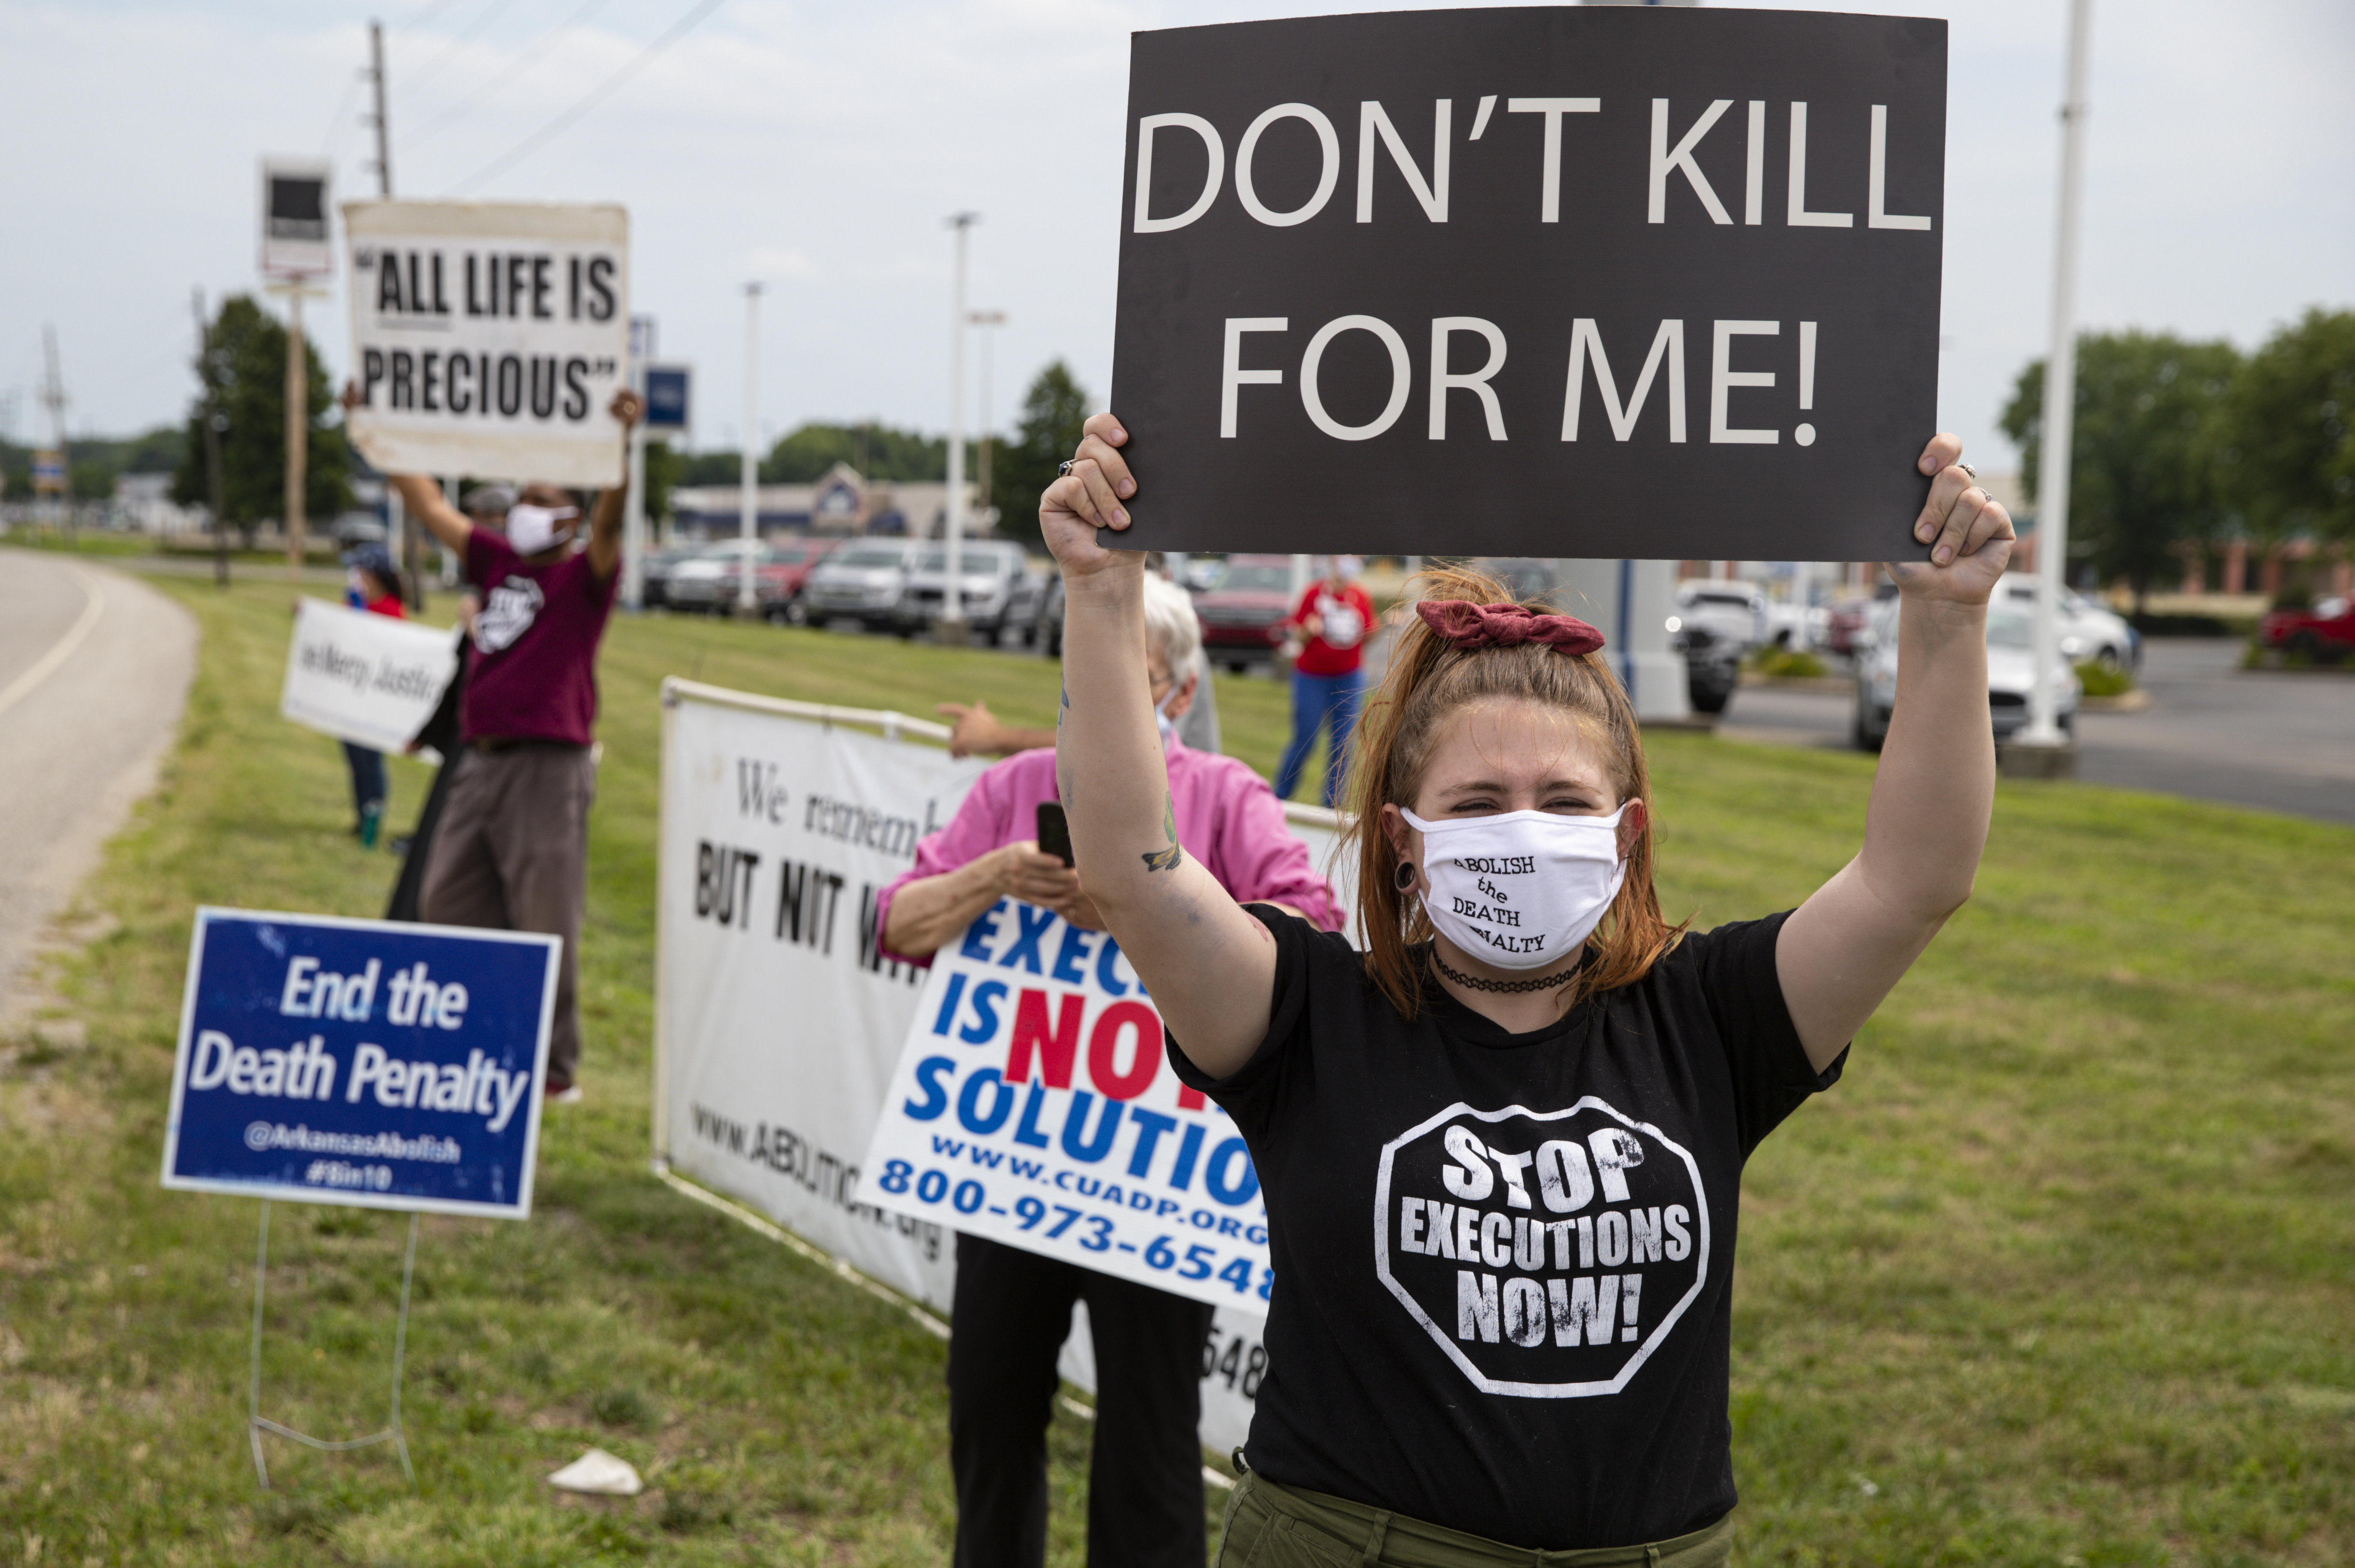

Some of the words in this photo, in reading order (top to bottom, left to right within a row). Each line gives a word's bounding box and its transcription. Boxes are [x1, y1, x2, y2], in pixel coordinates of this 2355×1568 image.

[1133, 94, 1601, 234] DON’T
[1647, 98, 1931, 232] KILL
[464, 251, 554, 321] LIFE
[568, 253, 618, 323] IS
[1220, 314, 1509, 442] FOR
[1561, 317, 1818, 448] ME!
[737, 756, 790, 826] We
[697, 836, 761, 927] BUT
[1452, 896, 1521, 927] DEATH
[1478, 876, 1507, 903] the
[960, 900, 1152, 998] EXEC
[280, 954, 382, 1023] End
[387, 961, 470, 1031] the
[188, 1028, 338, 1102] Death
[344, 1042, 530, 1134] Penalty
[932, 972, 1010, 1046] IS
[1004, 987, 1207, 1113] NO
[243, 1120, 461, 1164] @ArkansasAbolish
[904, 1055, 1268, 1216] SOLUTIO
[1442, 1124, 1644, 1213] STOP
[1400, 1195, 1692, 1272] EXECUTIONS
[1456, 1269, 1643, 1348] NOW!
